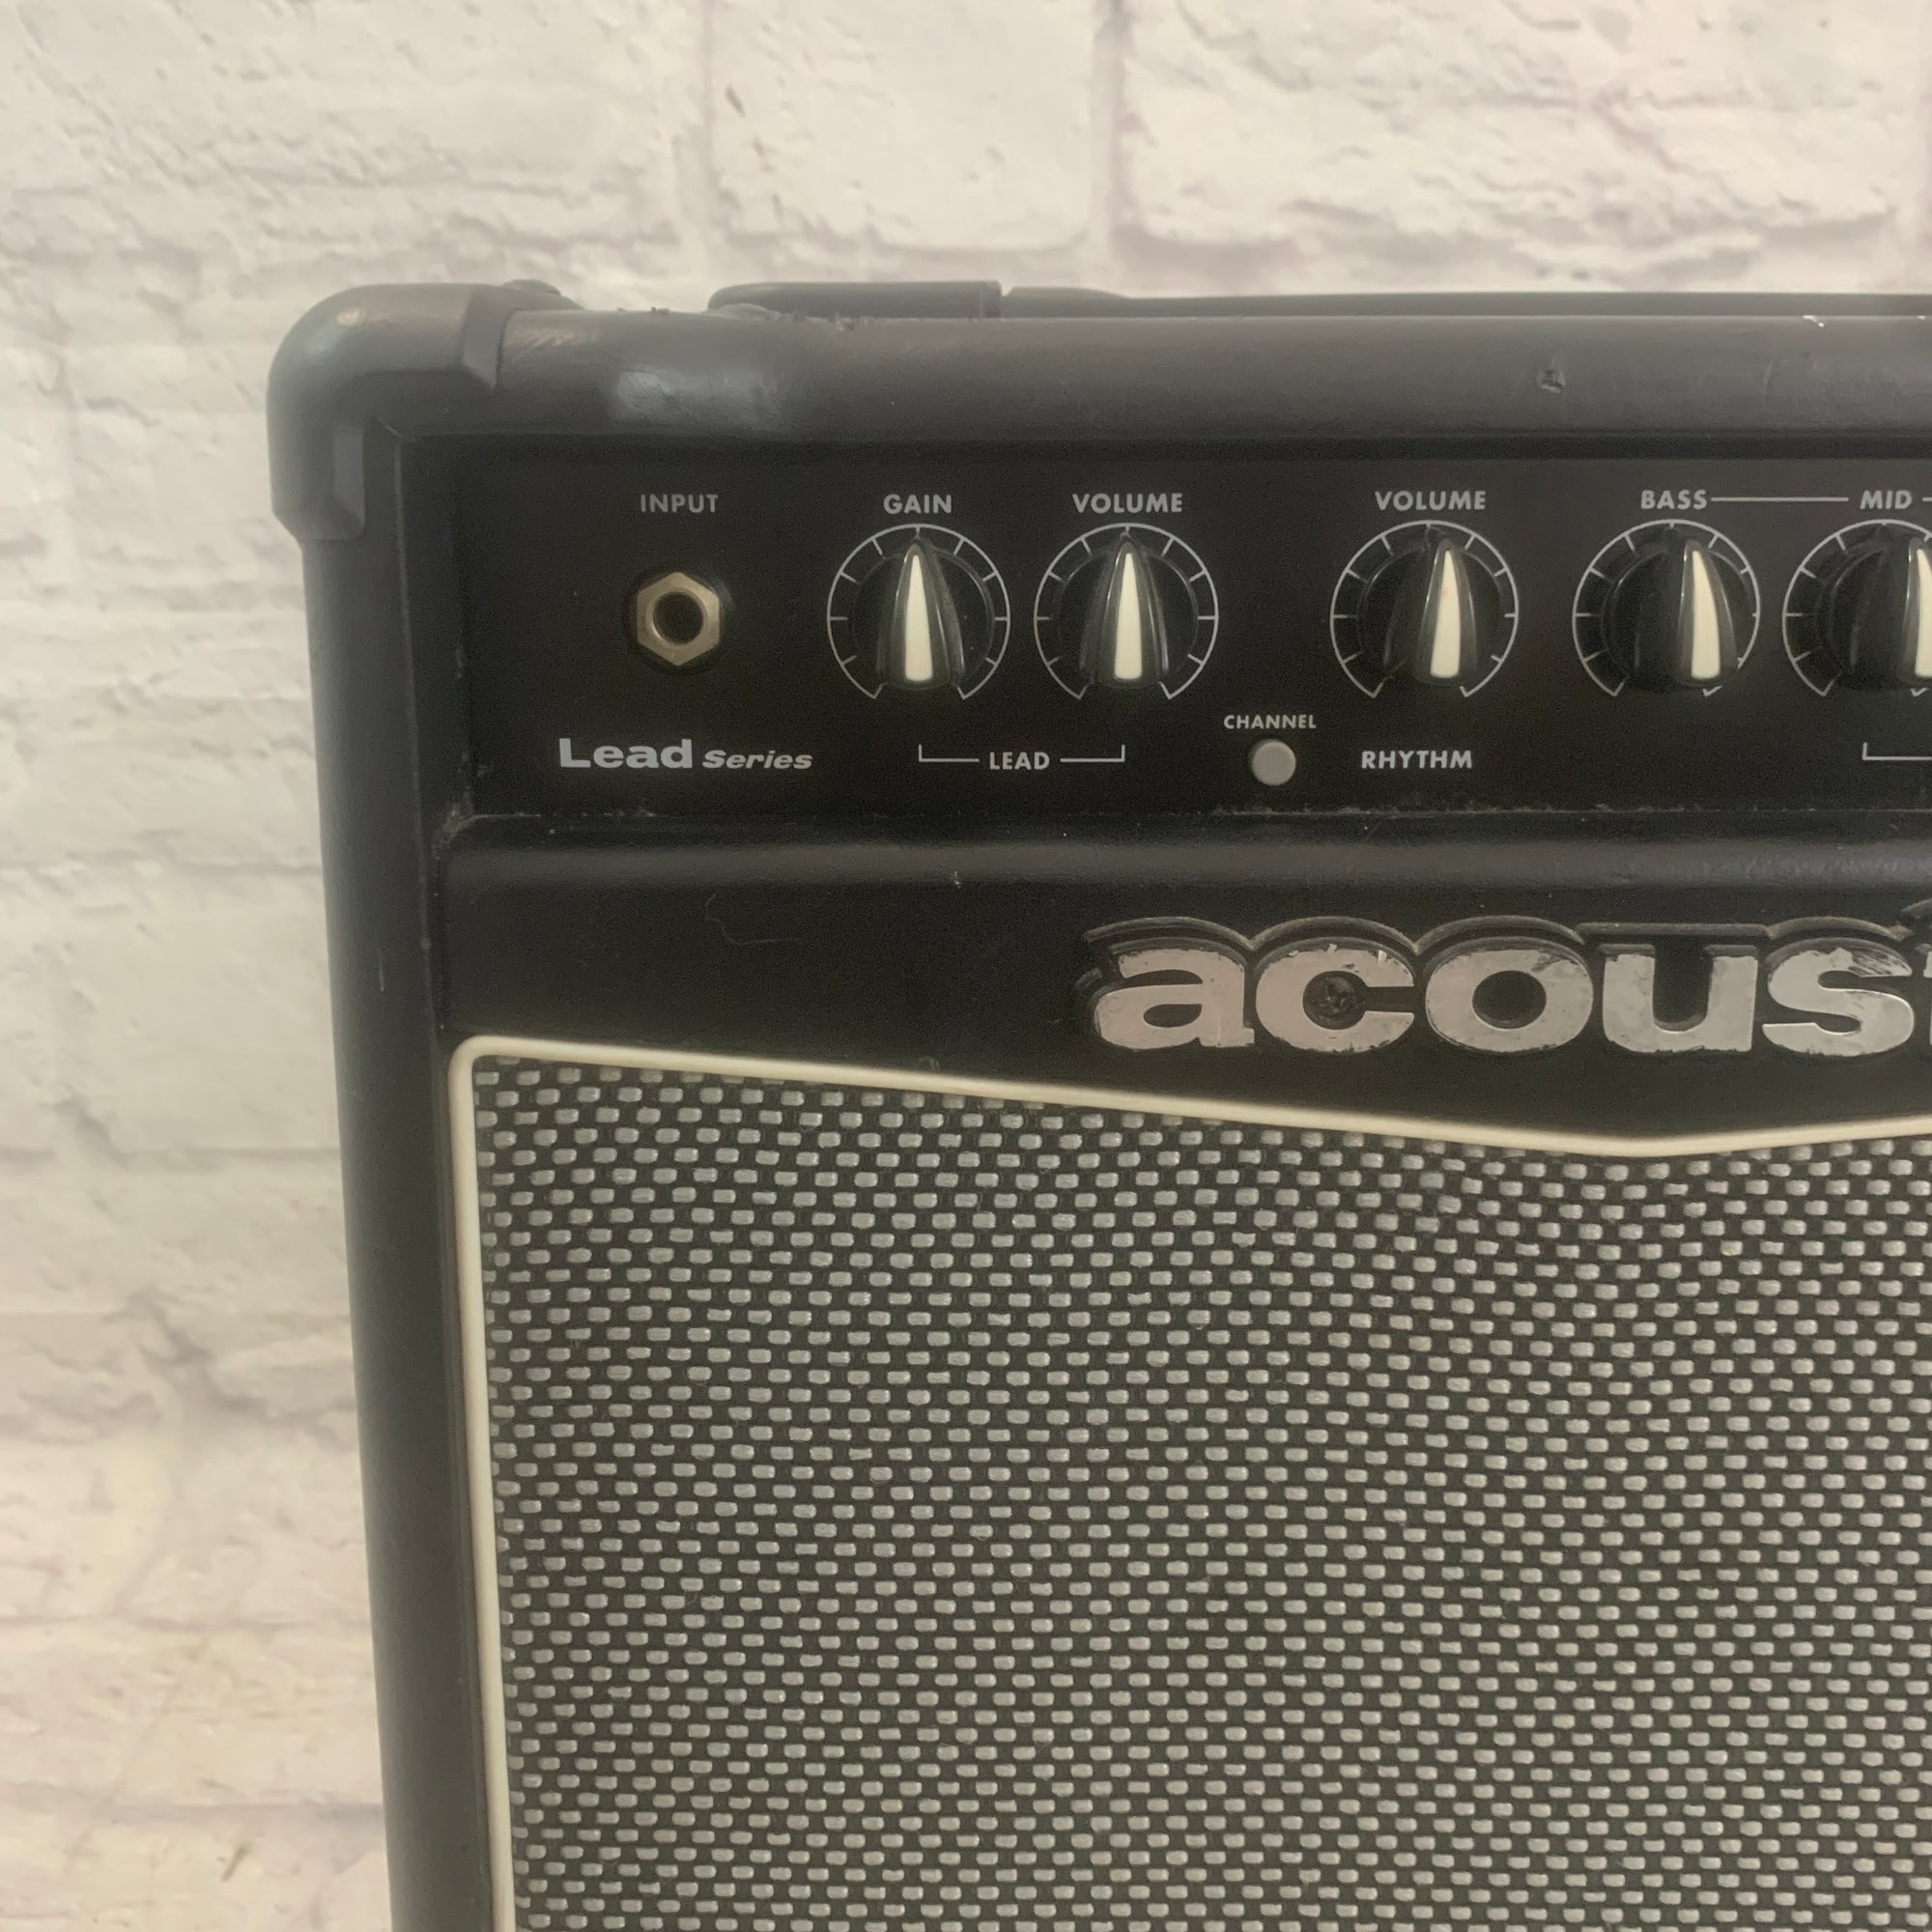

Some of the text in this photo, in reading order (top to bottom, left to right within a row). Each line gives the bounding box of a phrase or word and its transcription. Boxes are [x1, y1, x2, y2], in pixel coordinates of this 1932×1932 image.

[639, 494, 719, 513] INPUT
[883, 494, 952, 514] GAIN
[1072, 493, 1183, 513] VOLUME
[1375, 491, 1487, 511] VOLUME
[1640, 489, 1708, 510] BASS
[1860, 490, 1912, 510] MID
[1223, 714, 1317, 729] CHANNEL
[558, 737, 694, 769] Lead
[988, 751, 1050, 770] LEAD
[1361, 751, 1473, 769] RHYTHM
[1094, 945, 1932, 1058] acous
